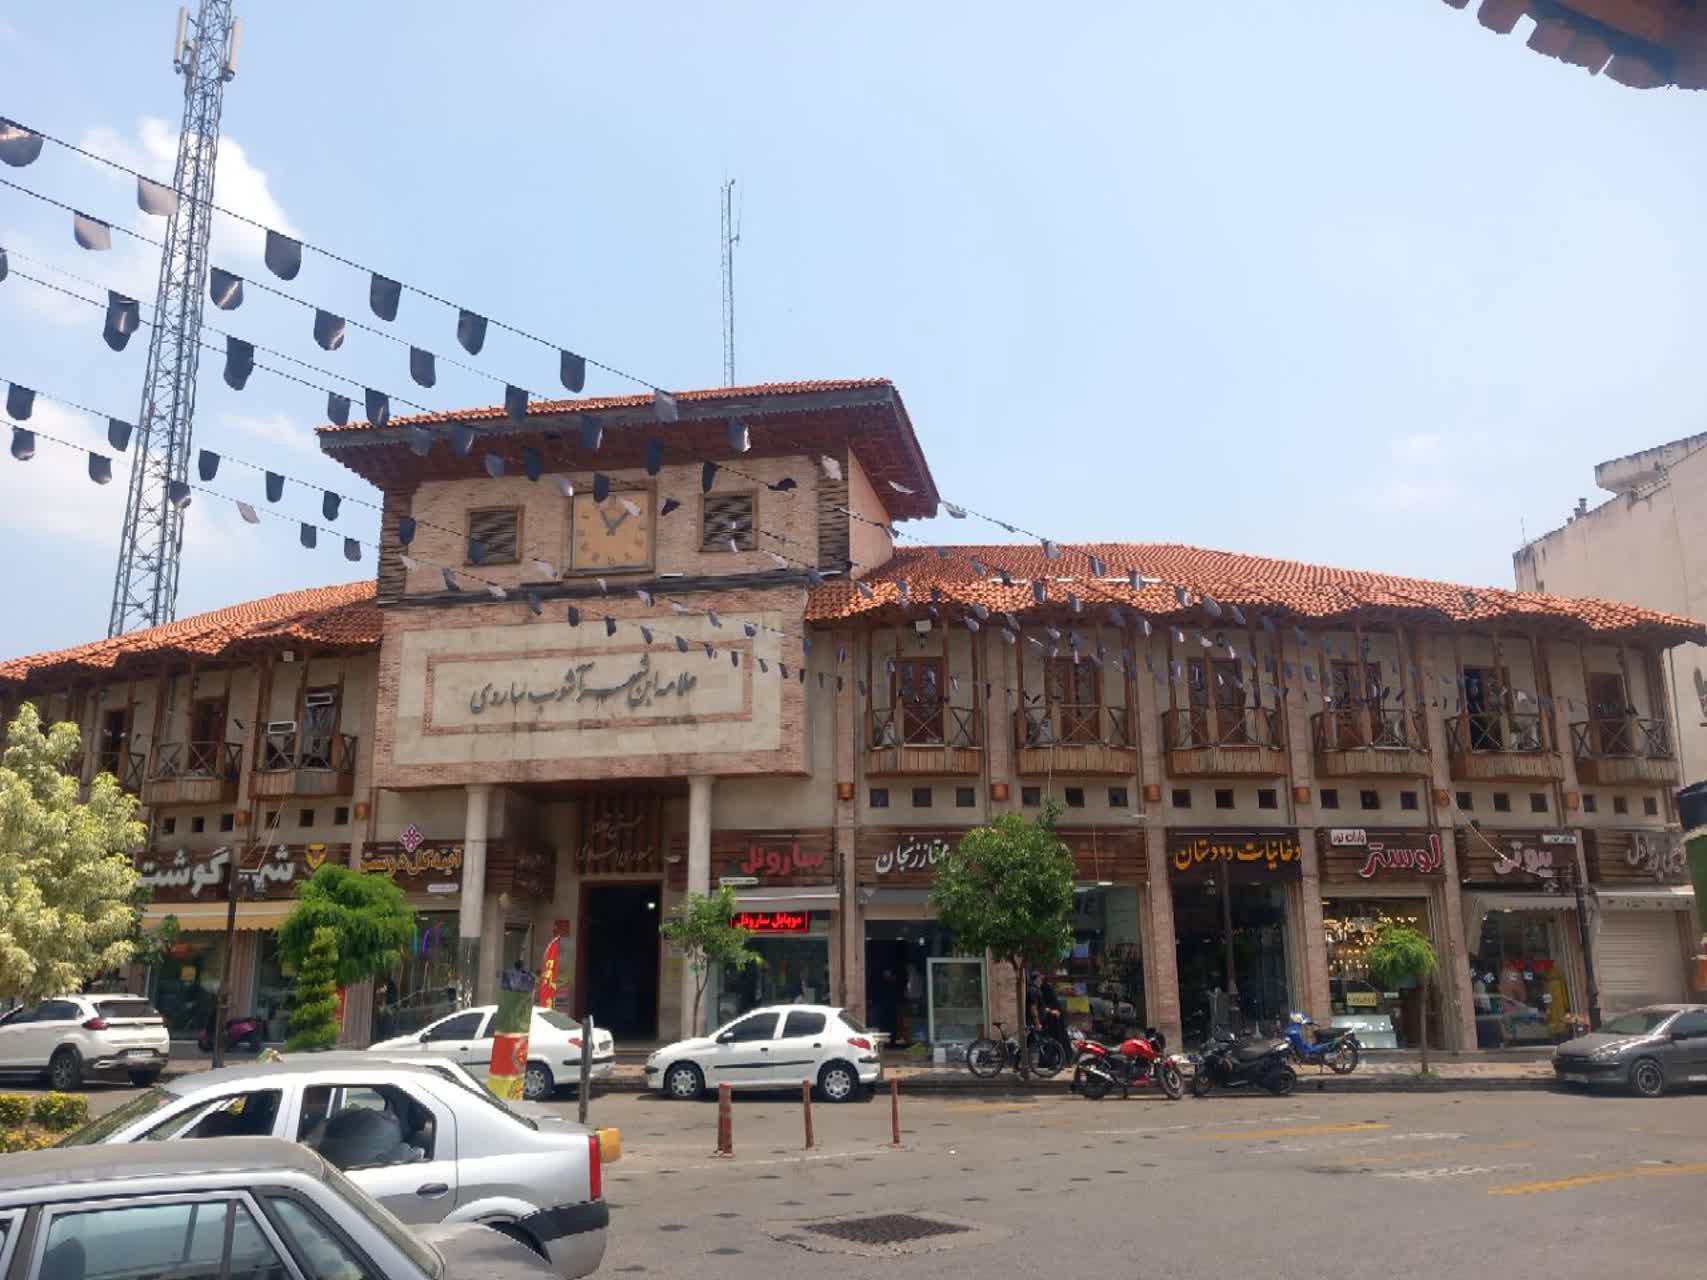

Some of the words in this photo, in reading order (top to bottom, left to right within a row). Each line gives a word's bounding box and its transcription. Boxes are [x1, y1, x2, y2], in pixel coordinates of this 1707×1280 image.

[470, 681, 528, 715] ساروی
[528, 661, 596, 714] آشوب
[628, 671, 659, 709] ابن
[656, 671, 697, 697] علامه
[1236, 839, 1303, 870] دخانیات
[1360, 834, 1440, 878] لوستر
